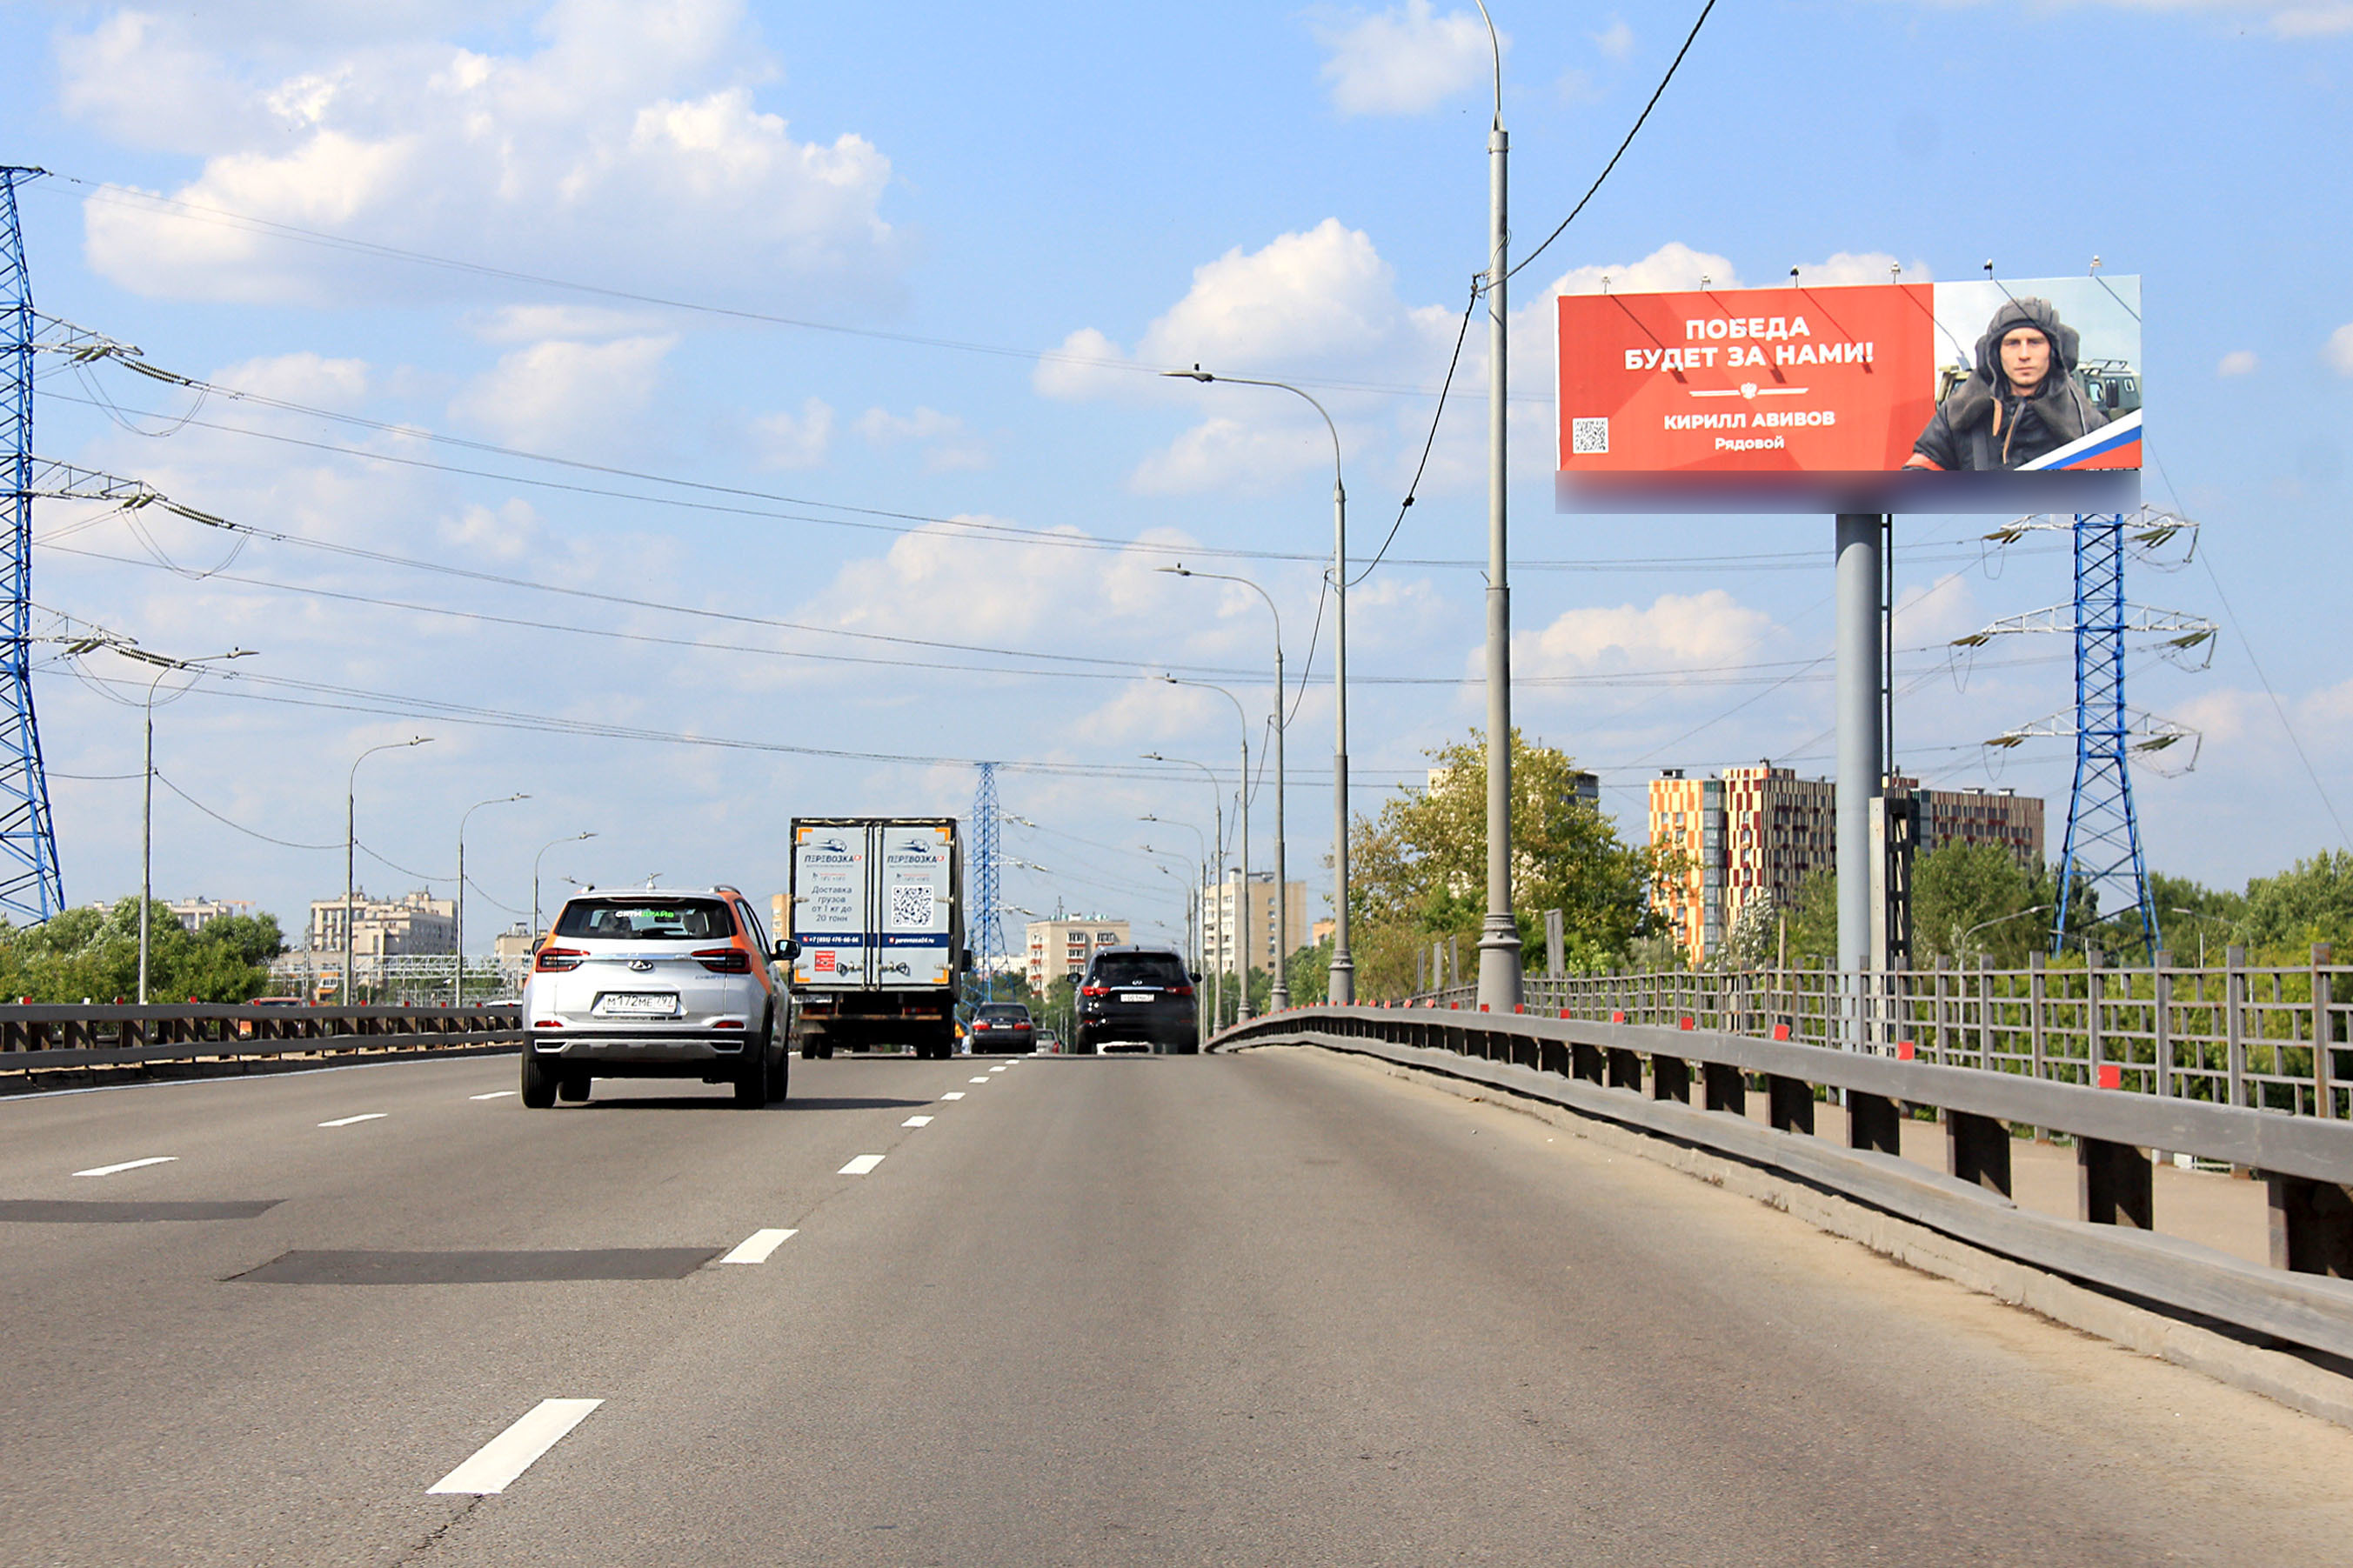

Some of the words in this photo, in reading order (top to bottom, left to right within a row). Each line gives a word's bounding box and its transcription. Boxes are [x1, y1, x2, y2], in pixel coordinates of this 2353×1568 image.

[1685, 317, 1810, 340] ПОБЕДА
[1624, 347, 1719, 371] БУДЕТ
[1726, 345, 1766, 367] ЗА
[1775, 341, 1874, 366] НАМИ!
[1663, 411, 1747, 430] КИРИЛЛ
[1751, 410, 1835, 428] АВИВОВ
[1715, 434, 1785, 451] Рядовой
[812, 885, 852, 895] Доставка
